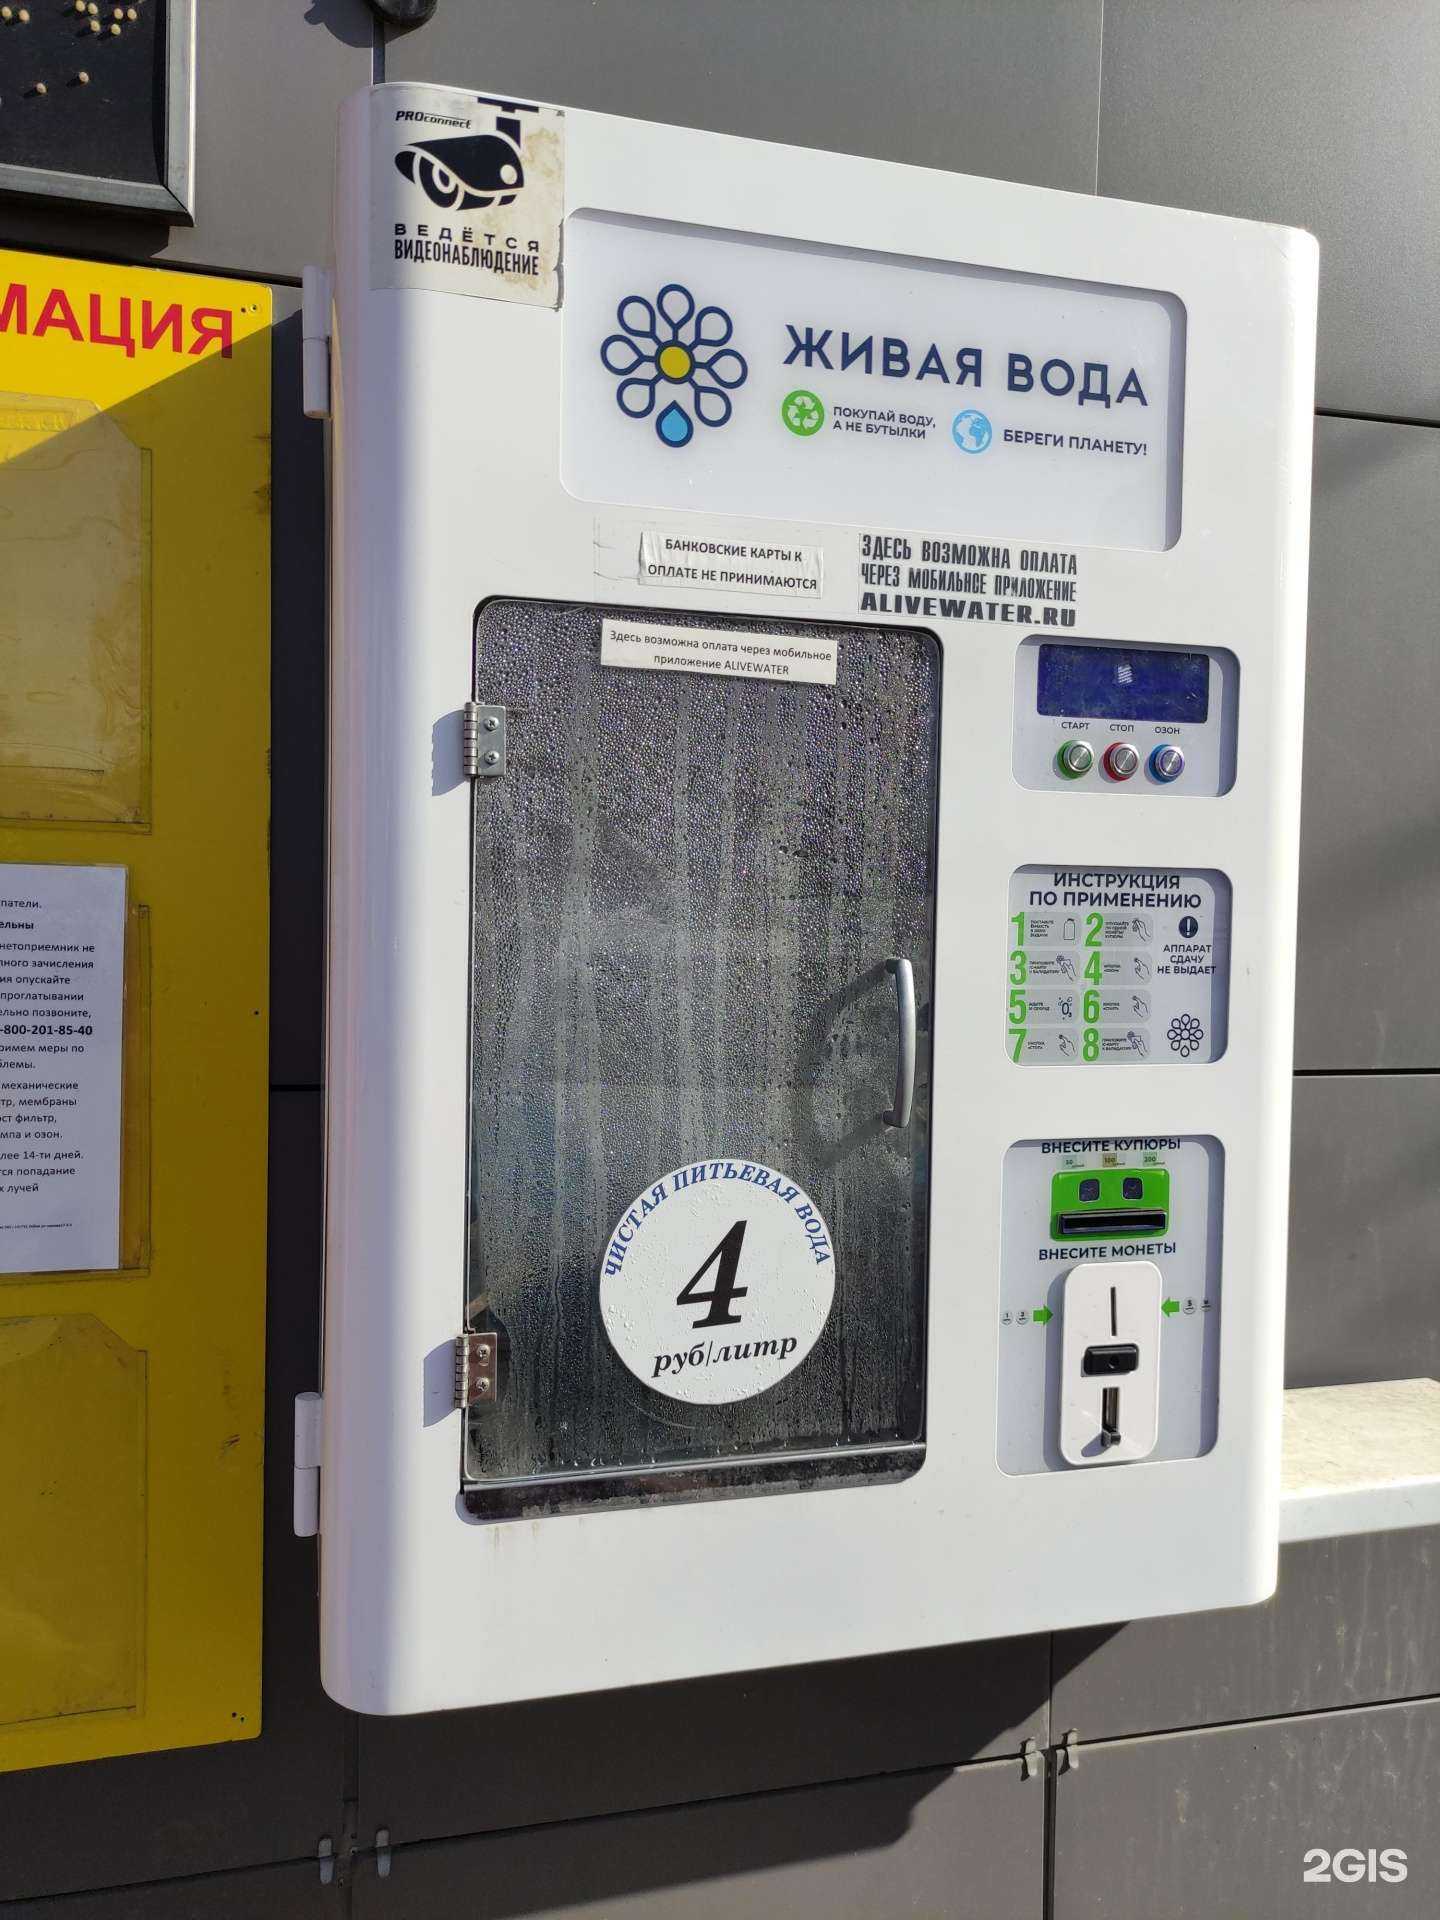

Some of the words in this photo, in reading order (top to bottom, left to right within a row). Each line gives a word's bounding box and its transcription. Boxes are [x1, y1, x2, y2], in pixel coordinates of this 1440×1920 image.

[395, 110, 472, 129] PROconnect
[395, 223, 539, 251] ВЕДЁТСЯ
[395, 239, 539, 275] ВИДЕОНАБЛЮДЕНИЕ
[783, 324, 983, 388] ЖИВАЯ
[1007, 352, 1149, 408] ВОДА
[833, 406, 896, 422] ПОКУПАЙ
[899, 414, 936, 428] ВОДУ,
[833, 420, 842, 430] А
[846, 421, 863, 432] НЕ
[866, 424, 926, 439] БУТЫЛКИ
[1003, 429, 1064, 447] БЕРЕГИ
[1069, 436, 1147, 456] ПЛАНЕТУ!
[665, 539, 747, 557] БАНКОВСКИЕ
[750, 548, 791, 561] КАРТЫ
[794, 552, 802, 562] К
[862, 535, 912, 560] ЗДЕСЬ
[922, 540, 1011, 569] ВОЗМОЖНА
[1020, 549, 1077, 575] ОПЛАТА
[648, 565, 698, 579] ОПЛАТЕ
[702, 570, 717, 581] НЕ
[720, 571, 817, 590] ПРИНИМАЮТСЯ
[861, 563, 900, 587] ЧЕРЕЗ
[908, 567, 987, 594] МОБИЛЬНОЕ
[994, 574, 1077, 602] ПРИЛОЖЕНИЕ
[861, 592, 1076, 627] ALIVEWATER.RU
[610, 630, 642, 643] Здесь
[645, 635, 699, 648] возможна
[702, 641, 738, 652] оплата
[740, 645, 771, 657] через
[773, 648, 832, 661] мобильное
[654, 655, 722, 669] приложение
[724, 660, 789, 675] ALIVEWATER
[1061, 721, 1090, 730] СТАРТ
[1109, 724, 1134, 733] СТОП
[1154, 726, 1180, 735] ОЗОН
[1054, 872, 1180, 890] ИНСТРУКЦИЯ
[1030, 891, 1057, 906] ПО
[1063, 892, 1202, 908] ПРИМЕНЕНИЮ
[1011, 911, 1025, 947] 1
[1085, 912, 1104, 947] 2
[1163, 944, 1213, 953] АППАРАТ
[31, 960, 94, 969] зачисления
[1010, 950, 1027, 985] 3
[1083, 951, 1102, 985] 4
[1170, 955, 1204, 965] СДАЧУ
[15, 974, 71, 986] опускайте
[1157, 966, 1172, 974] НЕ
[1174, 966, 1217, 976] ВЫДАЕТ
[1, 992, 84, 1001] проглатывании
[32, 1009, 92, 1018] позвоните,
[1009, 989, 1026, 1024] 5
[1083, 989, 1100, 1024] 6
[38, 1045, 69, 1054] меры
[71, 1045, 84, 1053] по
[1009, 1028, 1027, 1063] 7
[1083, 1027, 1099, 1062] 8
[1, 1082, 79, 1090] механические
[18, 1096, 77, 1108] мембраны
[15, 1114, 57, 1124] фильтр,
[34, 1131, 63, 1139] озон.
[23, 1151, 51, 1160] 14-ти
[53, 1150, 84, 1161] дней.
[1041, 1140, 1110, 1154] ВНЕСИТЕ
[1114, 1138, 1181, 1152] КУПЮРЫ
[16, 1167, 76, 1177] попадание
[7, 1182, 39, 1194] лучей
[605, 1183, 668, 1276] ЧИСТАЯ
[672, 1162, 800, 1204] ПИТЬЕВАЯ
[794, 1203, 831, 1265] ВОДА
[1039, 1246, 1107, 1261] ВНЕСИТЕ
[1111, 1242, 1176, 1257] МОНЕТЫ
[676, 1220, 748, 1329] 4
